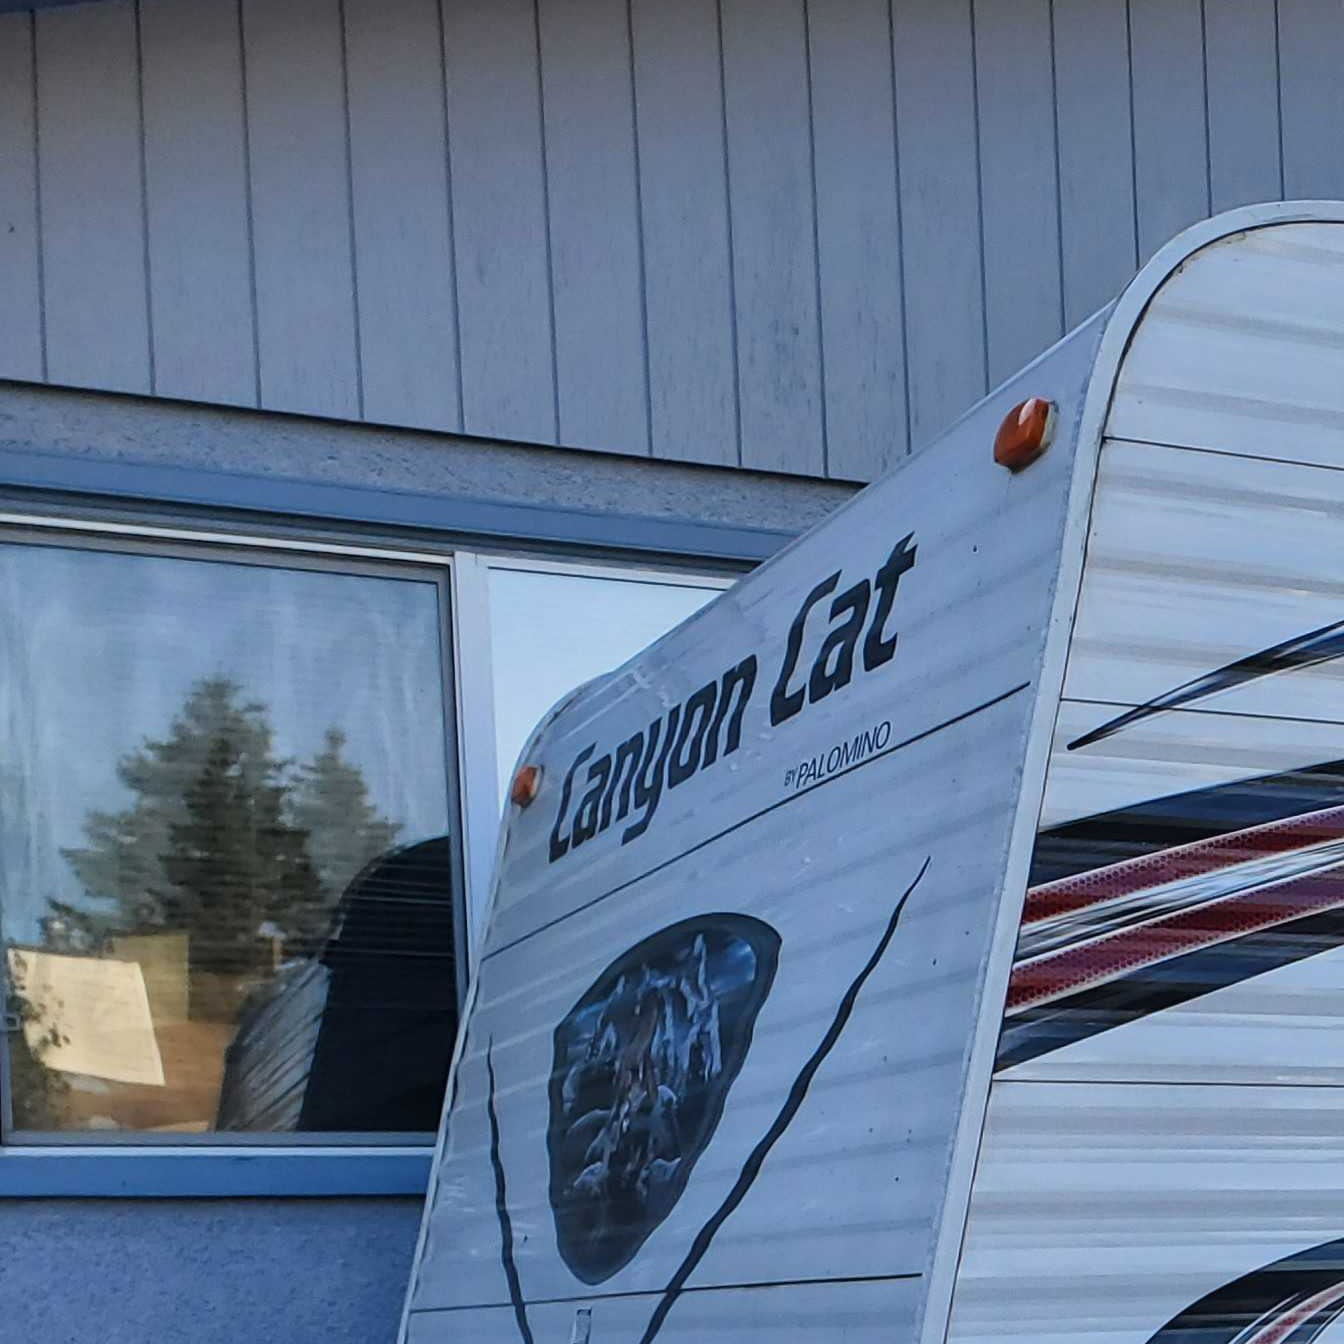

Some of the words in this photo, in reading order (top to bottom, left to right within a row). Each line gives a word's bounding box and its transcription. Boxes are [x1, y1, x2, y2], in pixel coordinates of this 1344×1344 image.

[549, 654, 757, 864] Canyon
[770, 531, 918, 727] Cat
[784, 769, 797, 787] BY
[798, 720, 891, 787] PALOMINO
